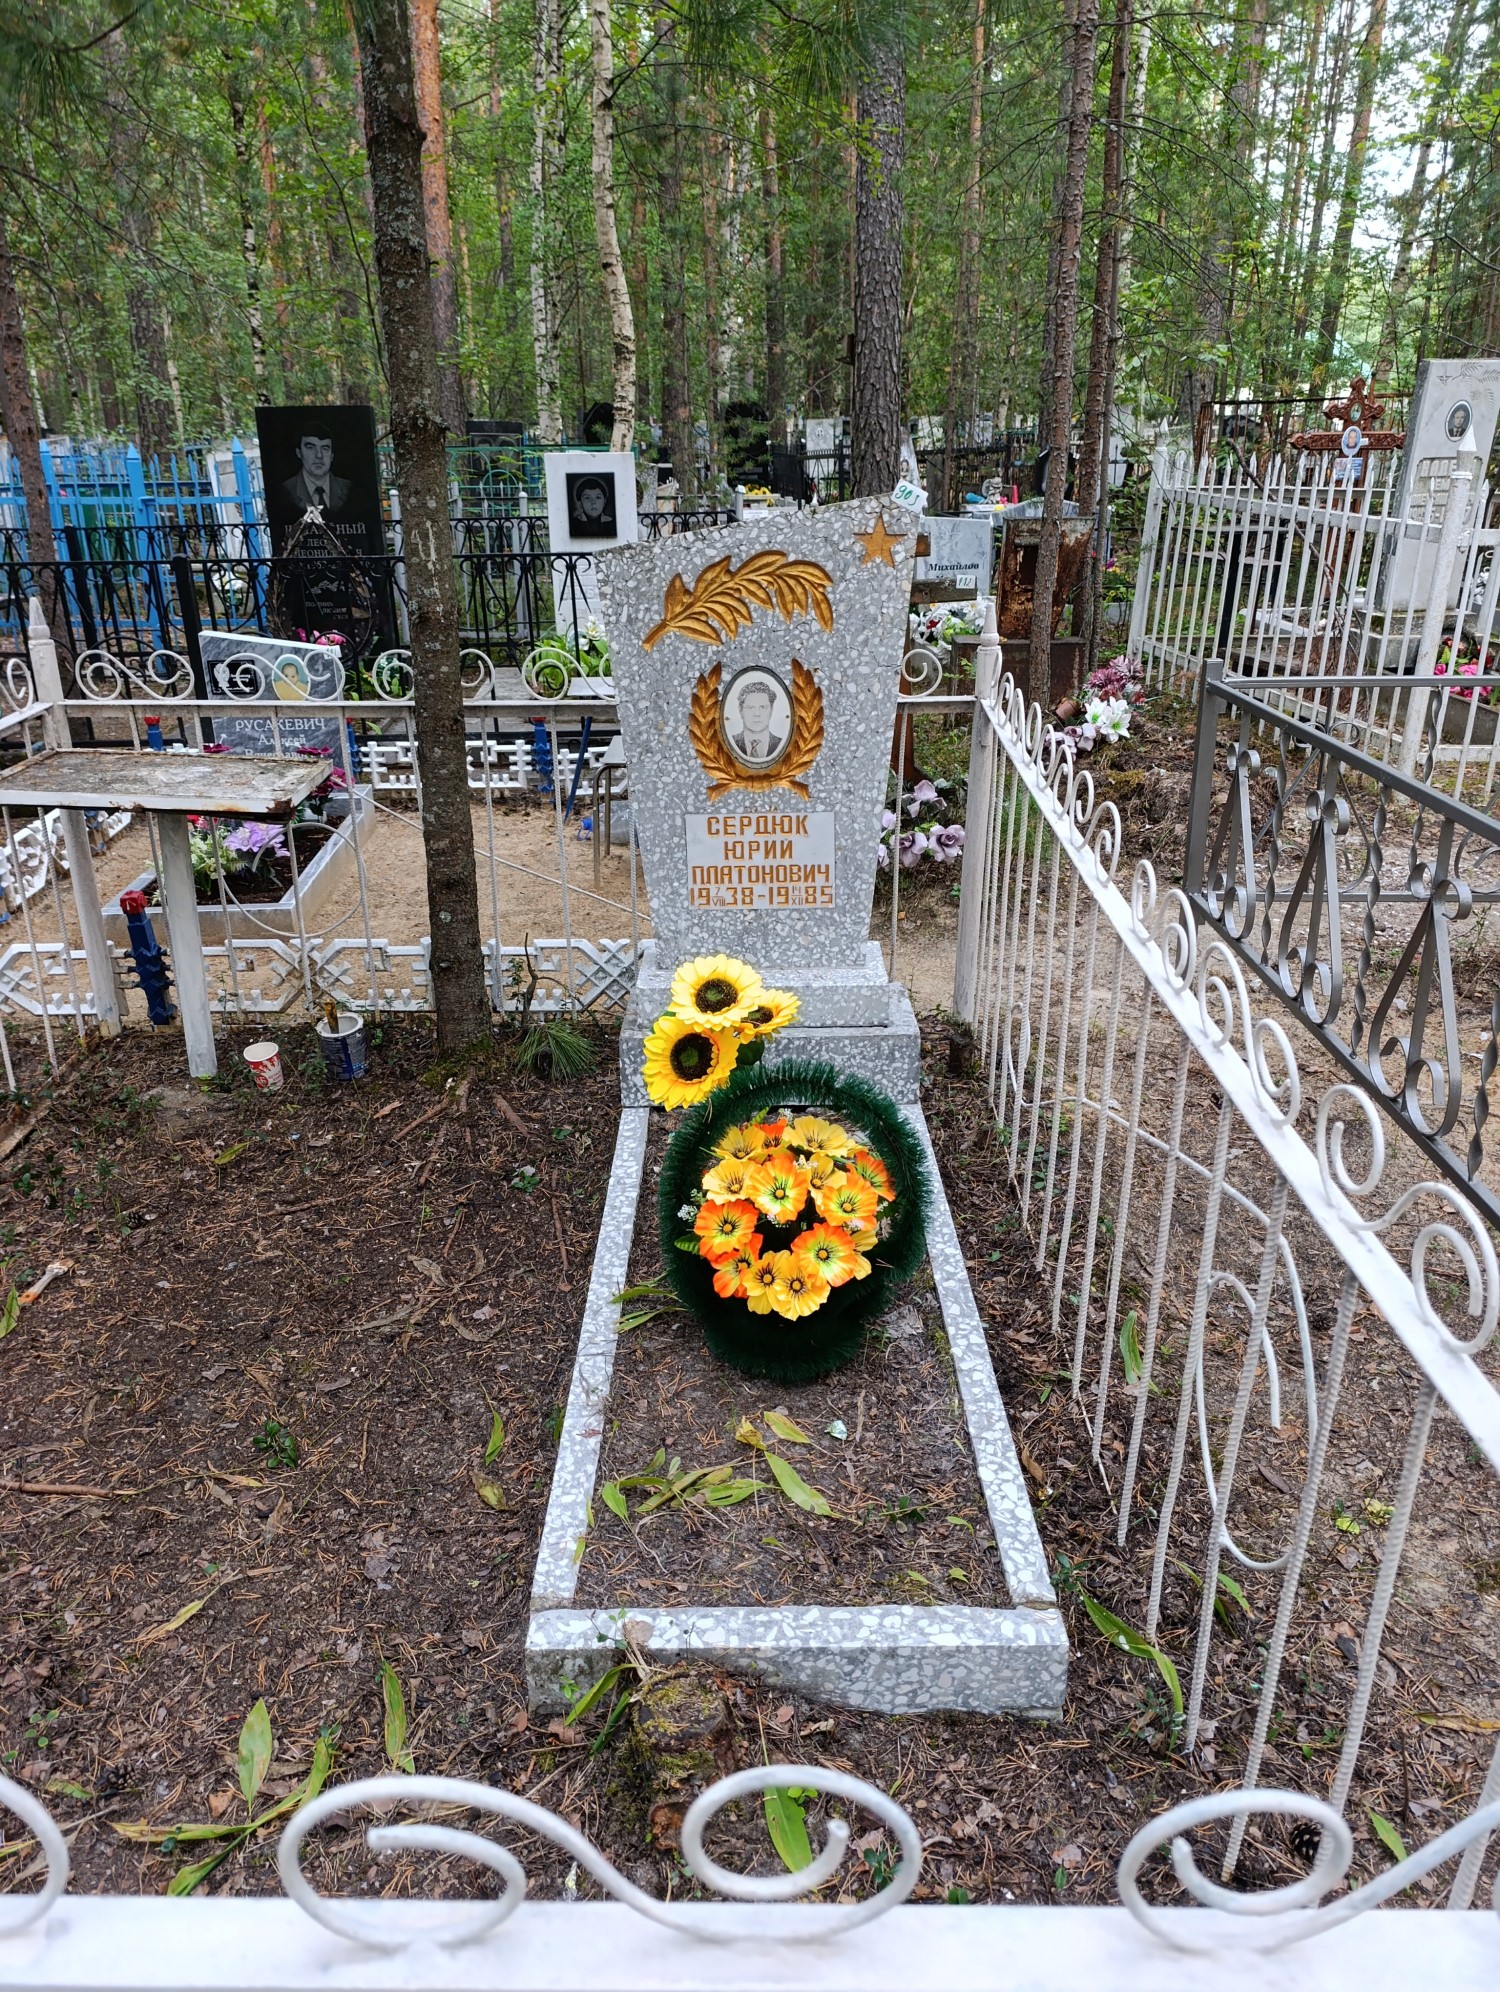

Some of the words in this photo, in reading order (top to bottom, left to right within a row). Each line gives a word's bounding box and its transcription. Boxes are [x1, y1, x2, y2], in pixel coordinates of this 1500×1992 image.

[928, 562, 980, 572] Михайлов
[258, 734, 306, 746] Алксей
[706, 815, 809, 836] СЕРДЮК
[724, 839, 793, 861] ЮРИЙ
[691, 864, 830, 885] ПЛАТОНОВИЧ
